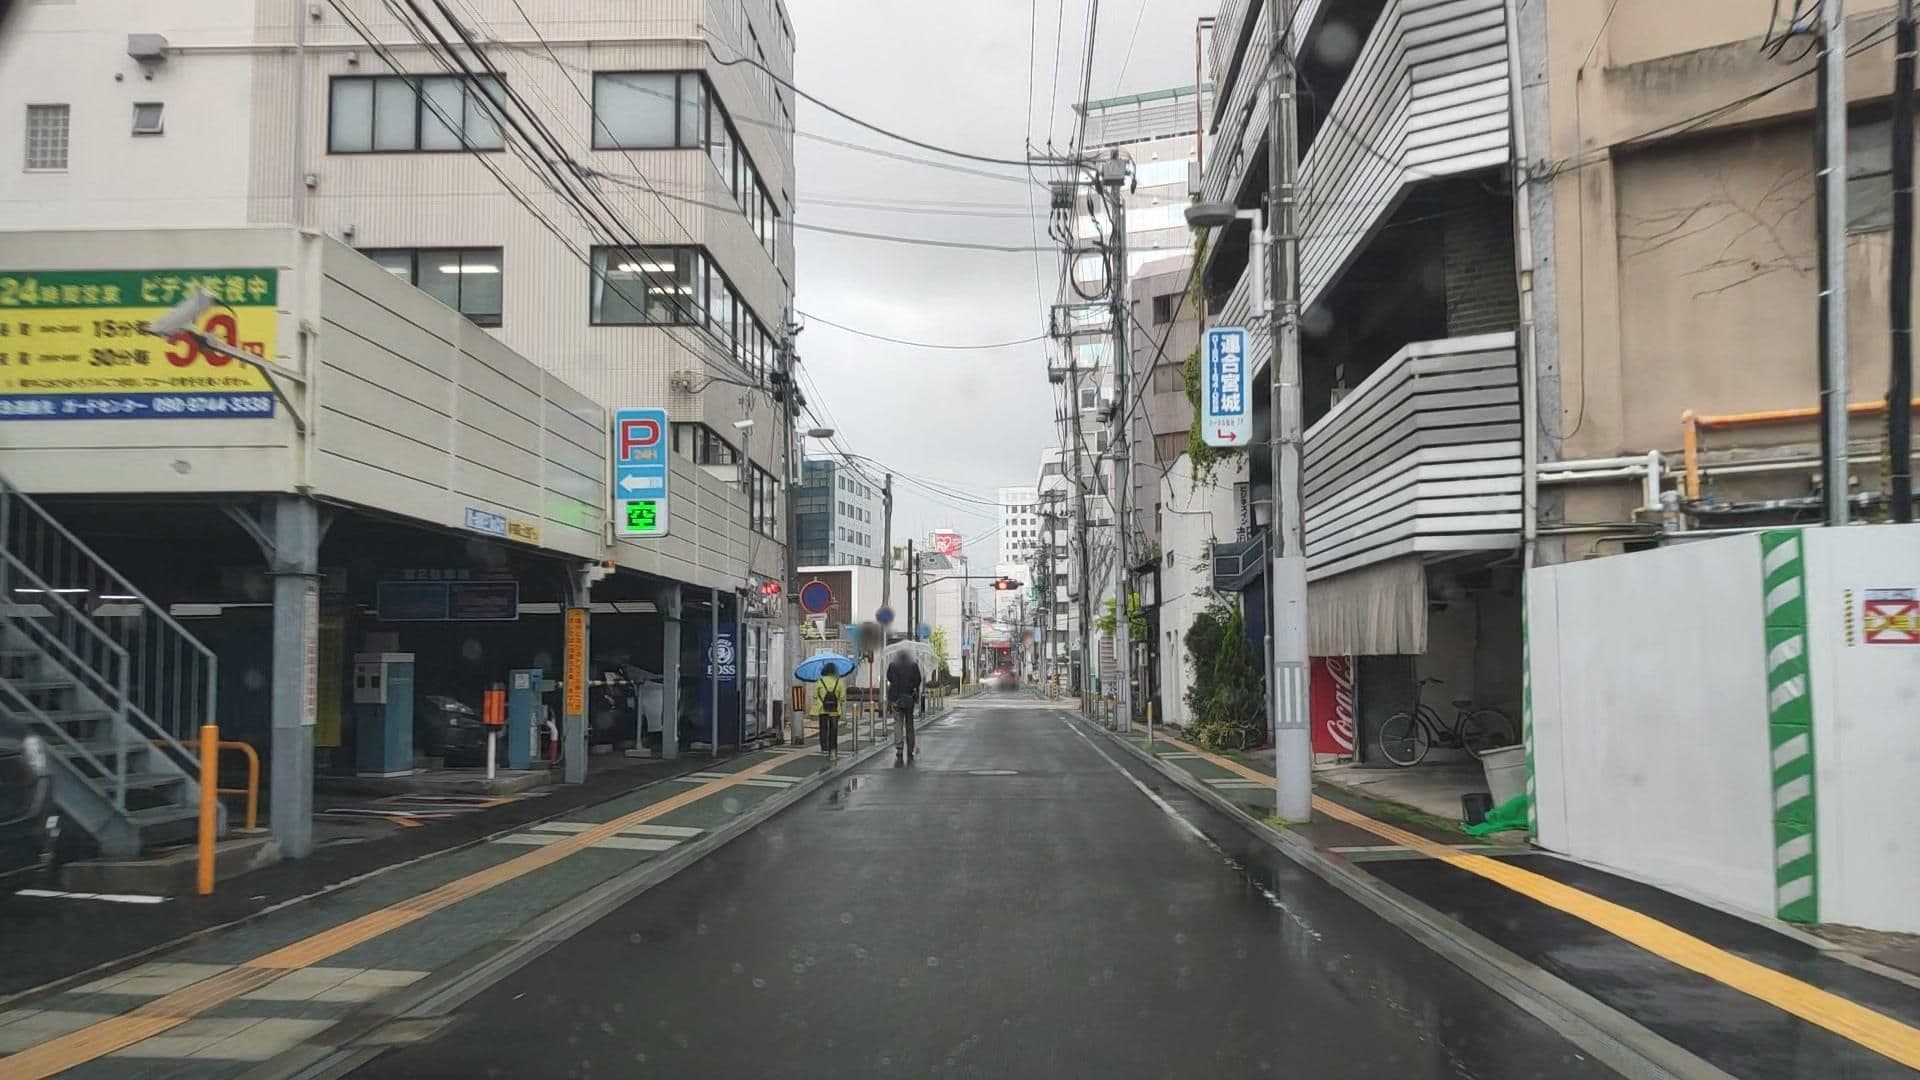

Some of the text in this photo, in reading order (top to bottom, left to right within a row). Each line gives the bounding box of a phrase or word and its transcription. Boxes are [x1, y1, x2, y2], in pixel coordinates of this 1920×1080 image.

[1221, 334, 1240, 412] 連合宮城
[620, 419, 661, 461] P
[627, 501, 656, 531] 空
